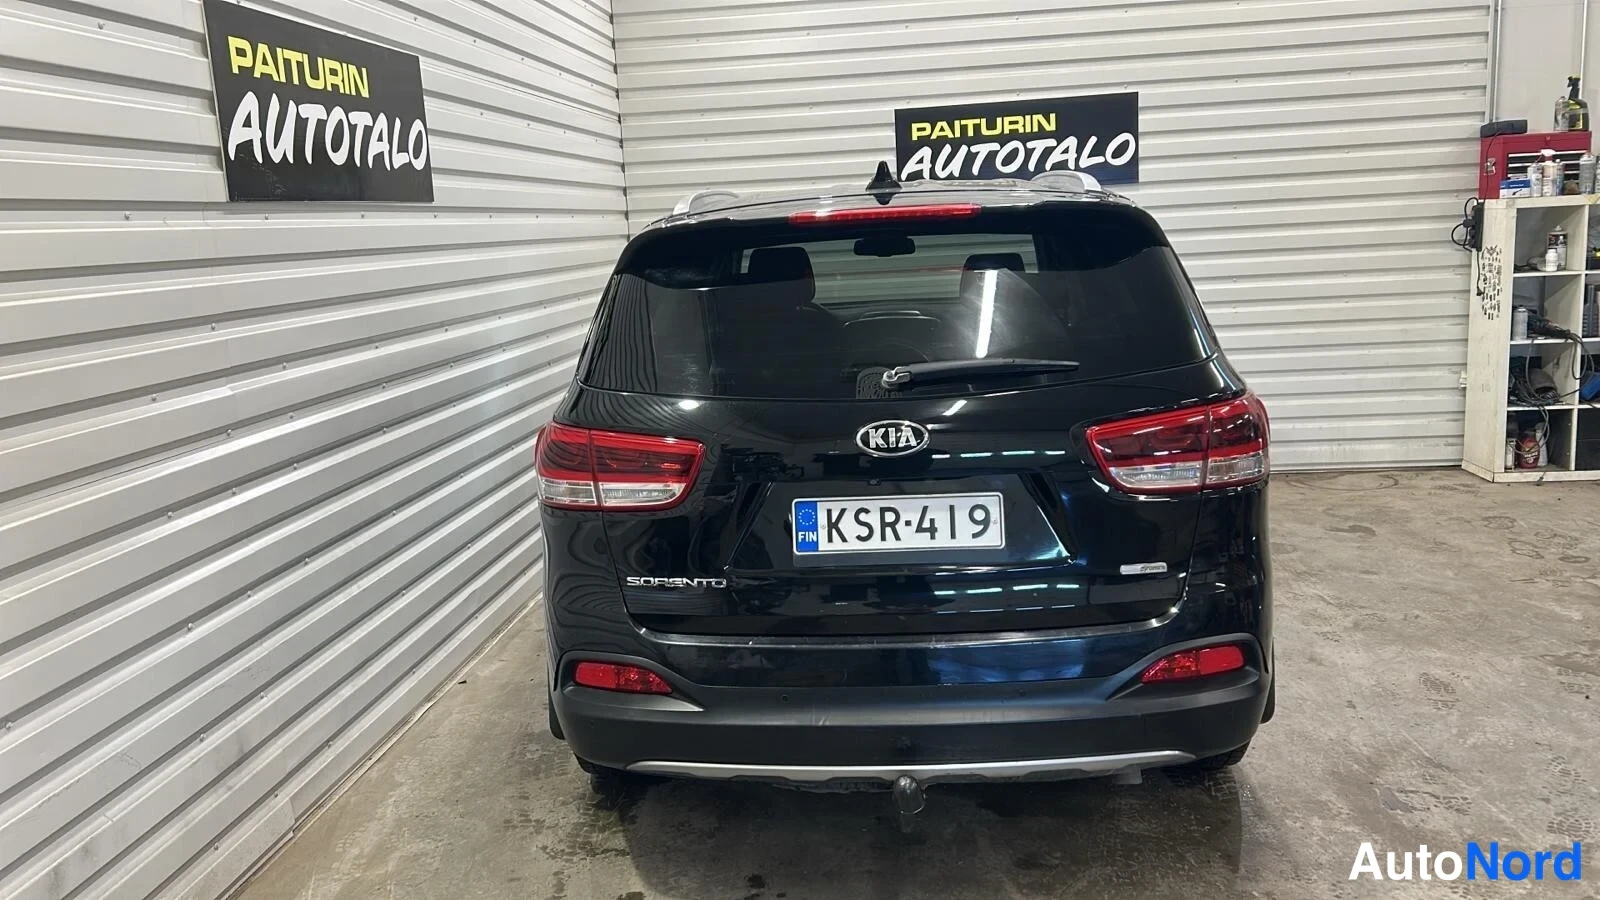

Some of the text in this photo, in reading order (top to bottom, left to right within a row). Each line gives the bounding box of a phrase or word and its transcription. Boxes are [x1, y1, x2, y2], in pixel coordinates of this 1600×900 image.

[227, 35, 370, 98] PAITURIN
[227, 91, 428, 171] AUTOTALO
[911, 112, 1056, 141] PAITURIN
[900, 132, 1136, 182] AUTOTALO
[868, 427, 918, 449] KIA
[798, 531, 818, 543] FIN
[826, 504, 991, 544] KSR-419
[626, 576, 727, 588] SORENTO
